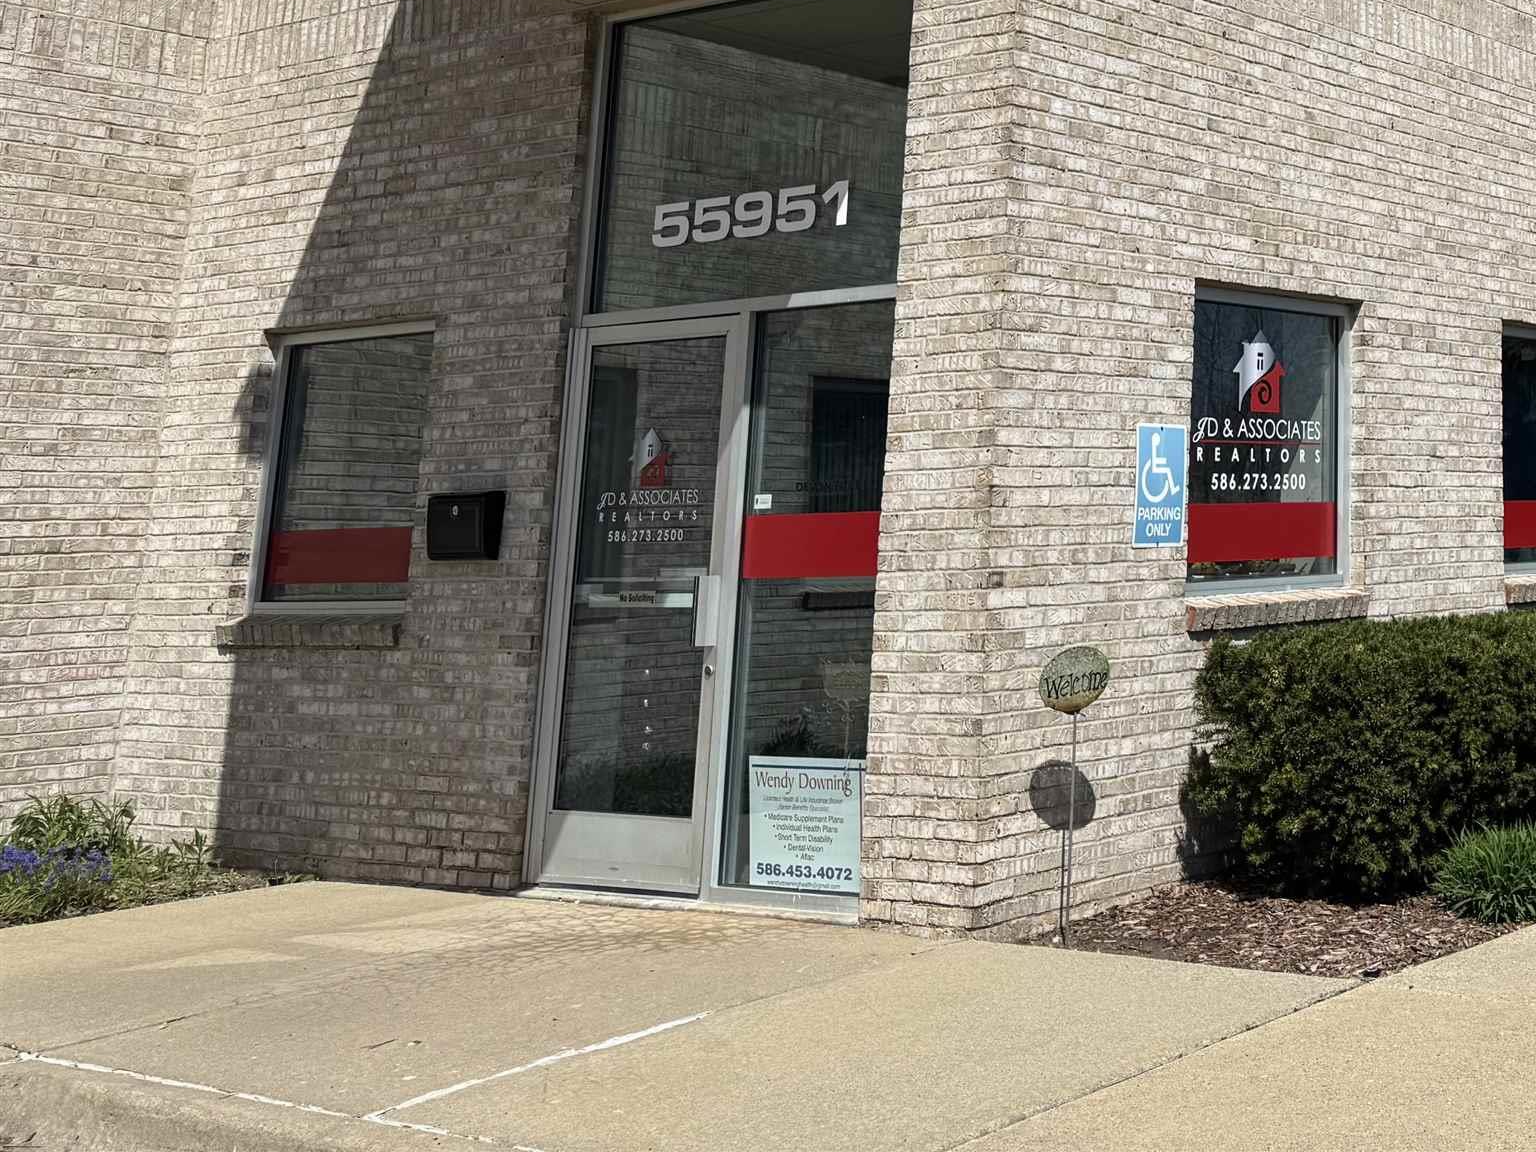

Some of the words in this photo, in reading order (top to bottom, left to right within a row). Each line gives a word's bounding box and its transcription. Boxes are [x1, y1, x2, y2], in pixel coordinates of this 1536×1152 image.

[652, 180, 849, 248] 55951
[1193, 416, 1218, 443] JD
[1223, 418, 1234, 438] &
[1237, 418, 1321, 440] ASSOCIATES
[1196, 447, 1321, 463] REALTORS
[1211, 473, 1306, 490] 586.273.2500
[618, 492, 627, 505] &
[630, 489, 699, 505] ASSOCIATES
[598, 510, 697, 523] REALTORS
[1138, 507, 1181, 521] PARKING
[608, 528, 684, 542] 586.273.2500
[1146, 523, 1172, 537] ONLY
[1044, 670, 1108, 699] Welcome
[755, 771, 795, 795] Wendy
[799, 772, 853, 797] Downing
[768, 813, 793, 821] Medicare
[794, 814, 827, 823] Supplement
[828, 815, 844, 823] Plans
[803, 825, 822, 833] Health
[808, 835, 833, 845] Disability
[756, 862, 853, 880] 586.453.4072
